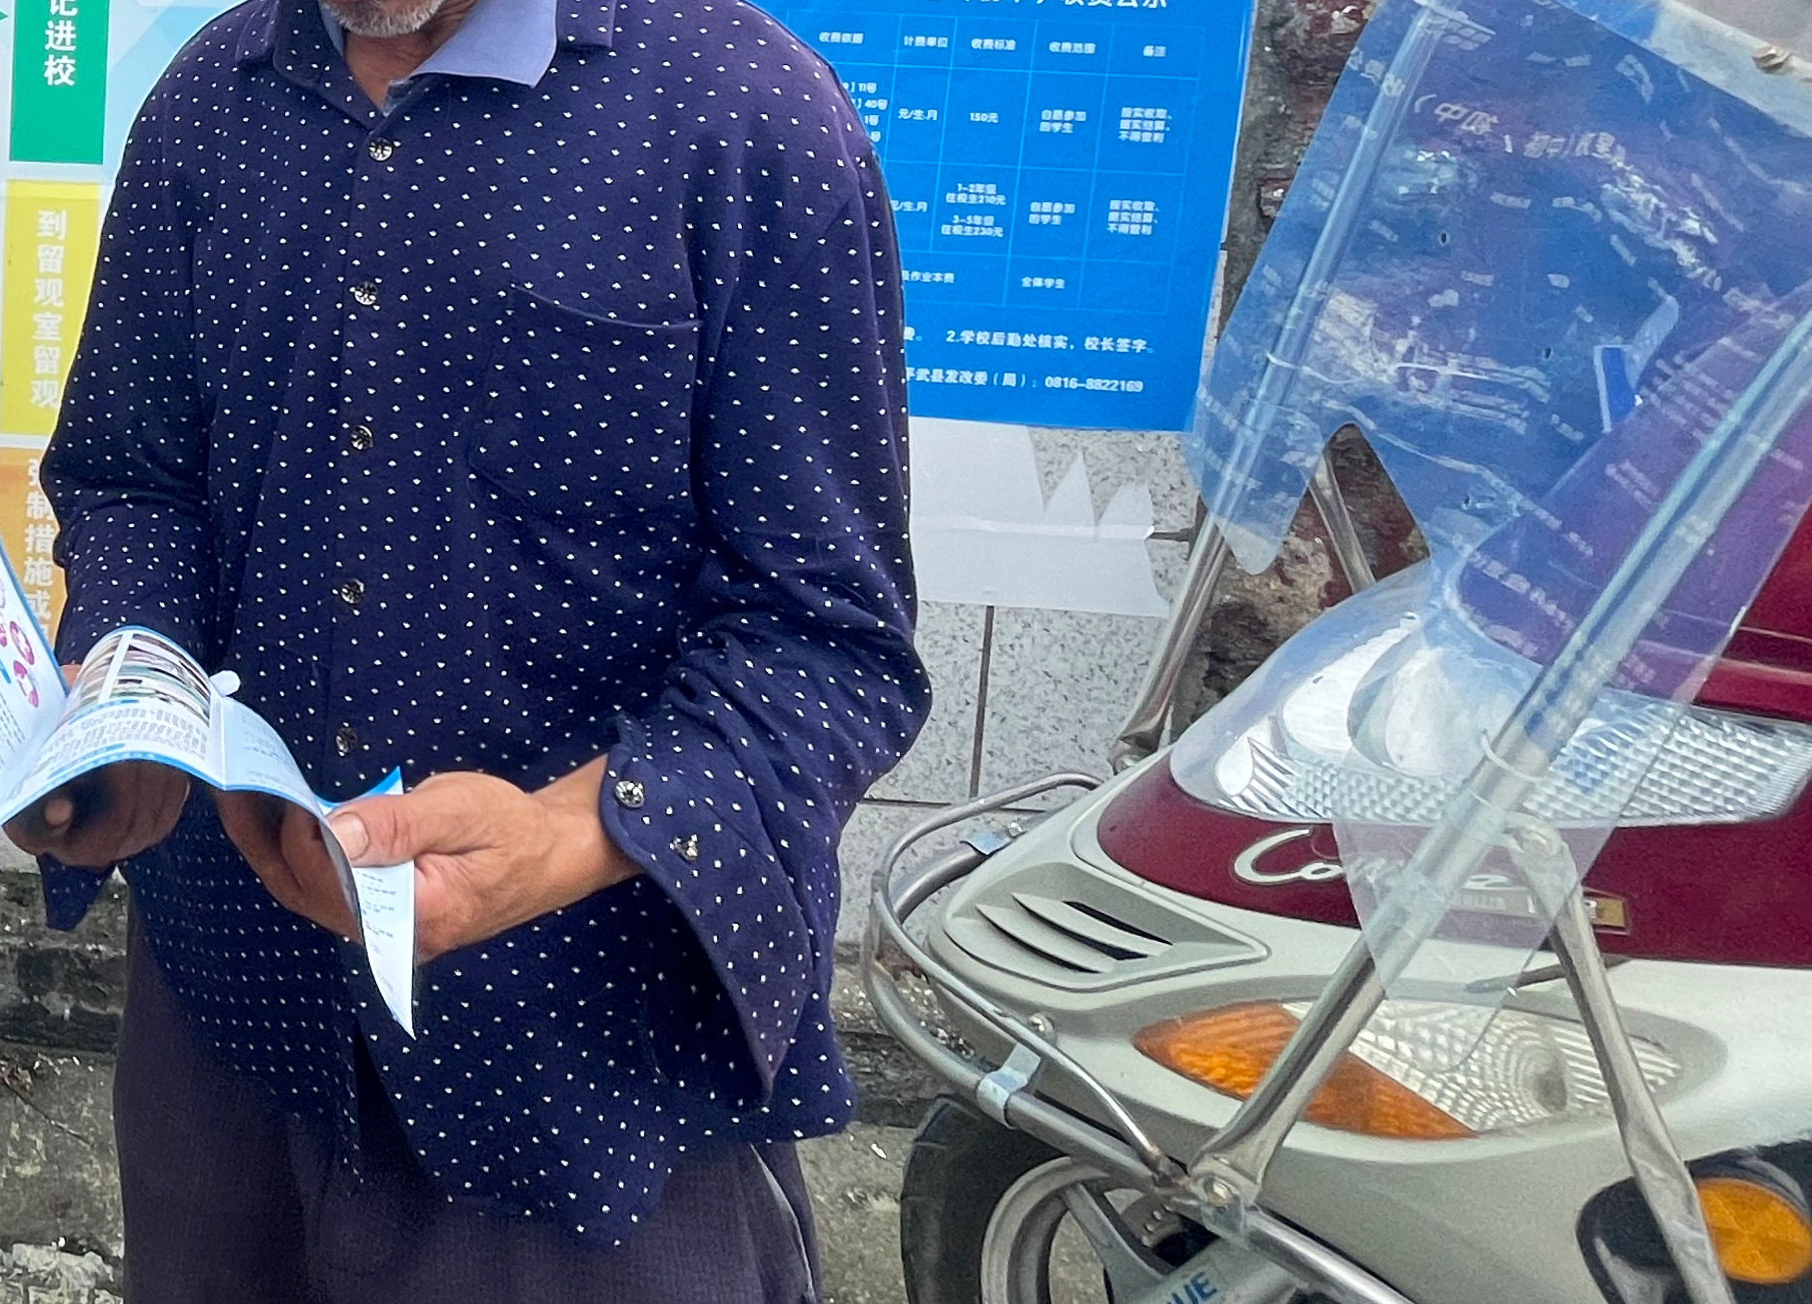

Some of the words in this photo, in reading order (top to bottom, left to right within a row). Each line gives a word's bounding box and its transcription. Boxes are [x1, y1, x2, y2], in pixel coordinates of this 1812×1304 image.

[29, 208, 68, 409] 到留观室留观
